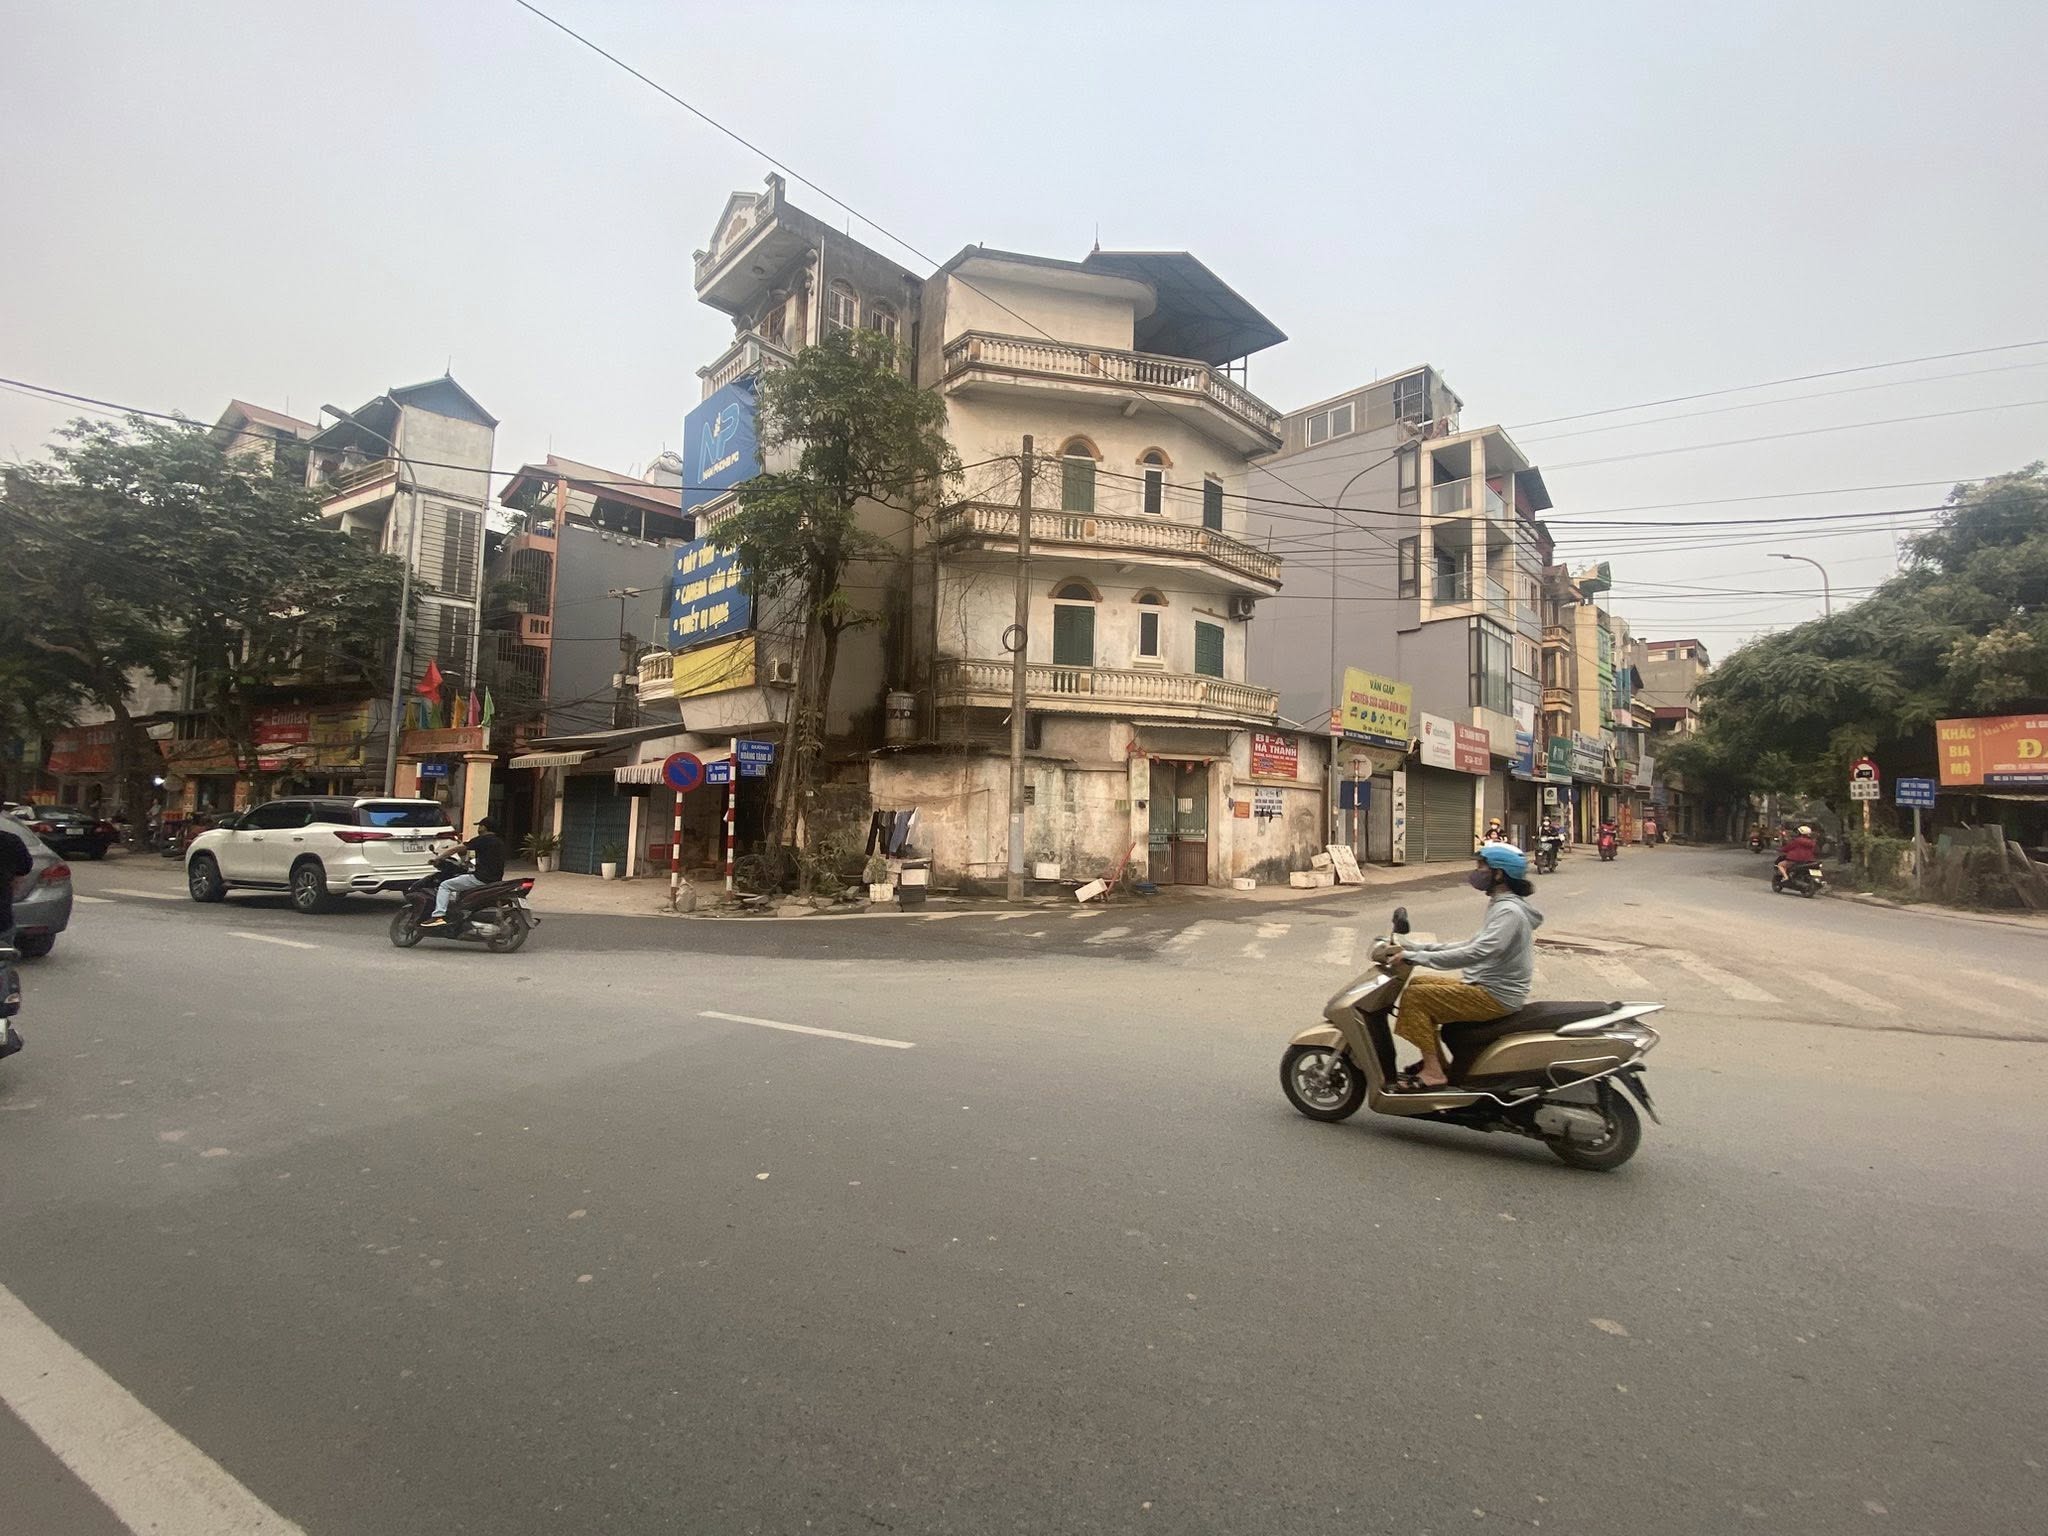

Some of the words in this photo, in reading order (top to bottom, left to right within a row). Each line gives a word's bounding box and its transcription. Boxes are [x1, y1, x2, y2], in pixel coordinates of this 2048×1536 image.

[1255, 733, 1285, 746] BI-A
[1270, 745, 1297, 757] THANH
[1949, 745, 1971, 758] BIA
